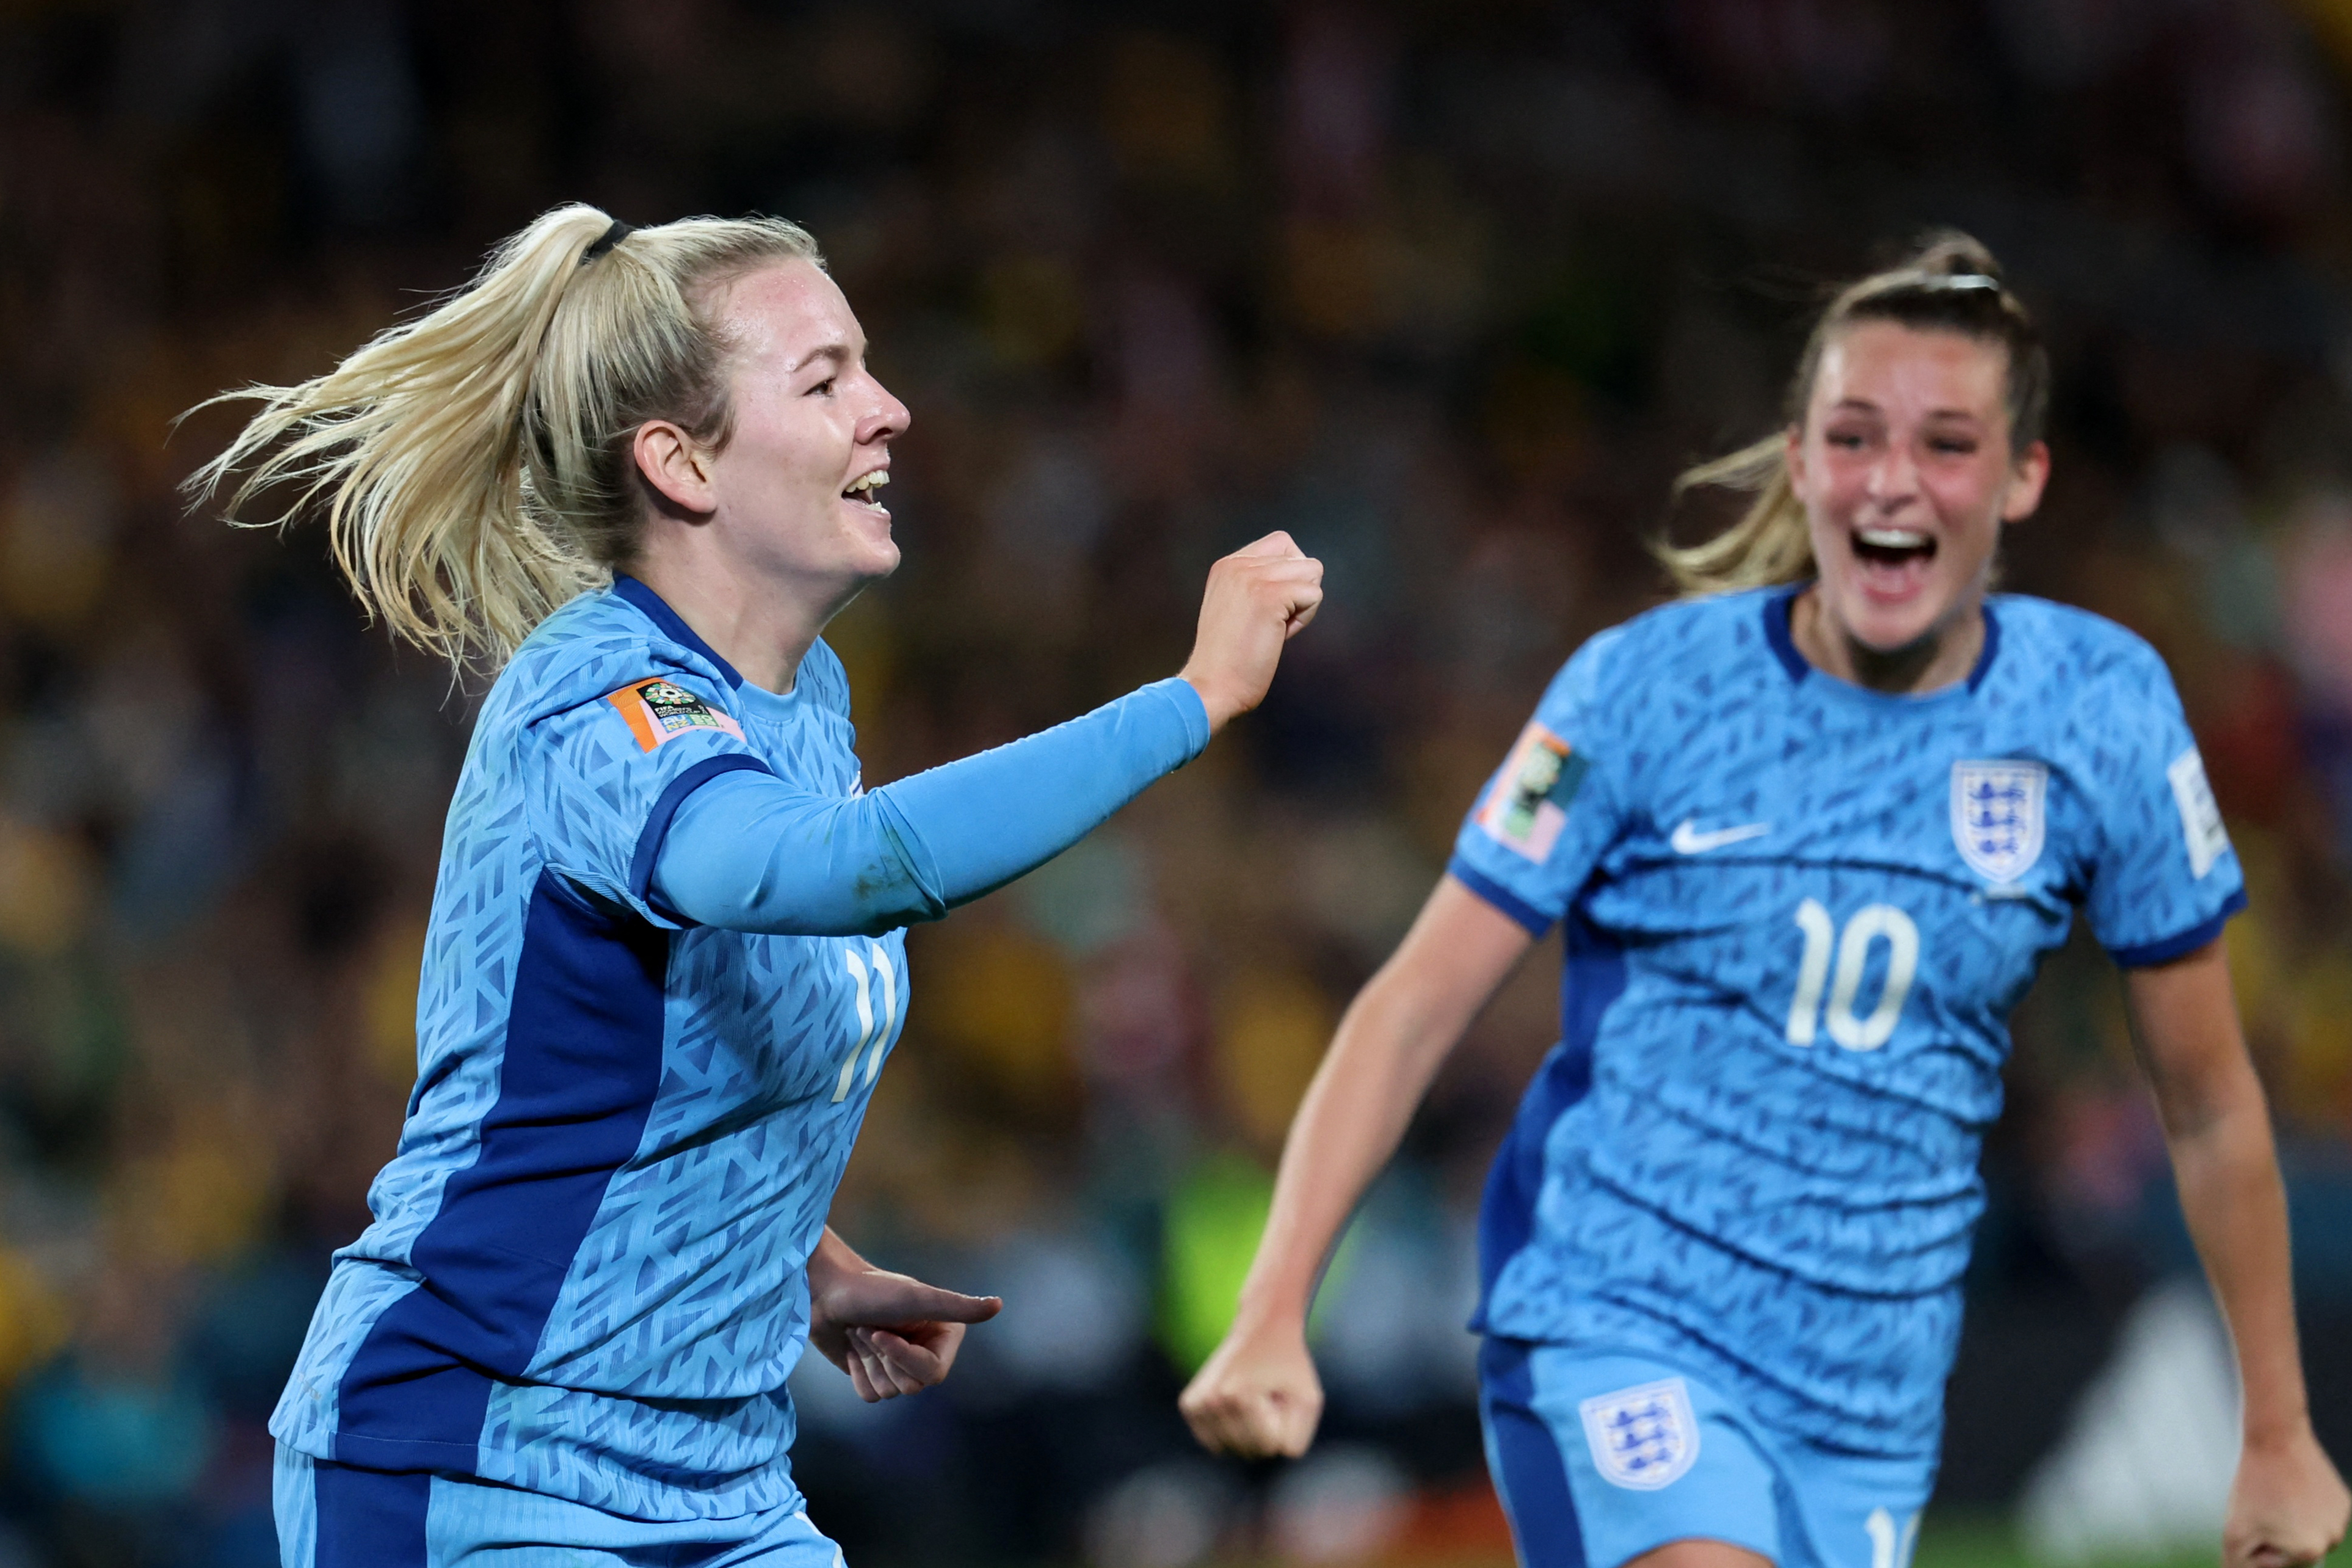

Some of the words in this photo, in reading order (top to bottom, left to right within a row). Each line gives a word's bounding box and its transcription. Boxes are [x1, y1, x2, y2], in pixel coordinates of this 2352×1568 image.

[663, 714, 686, 725] AU
[667, 720, 691, 731] NZ
[1786, 897, 1919, 1052] 10
[831, 943, 896, 1103] 11
[1865, 1506, 1922, 1568] 1
